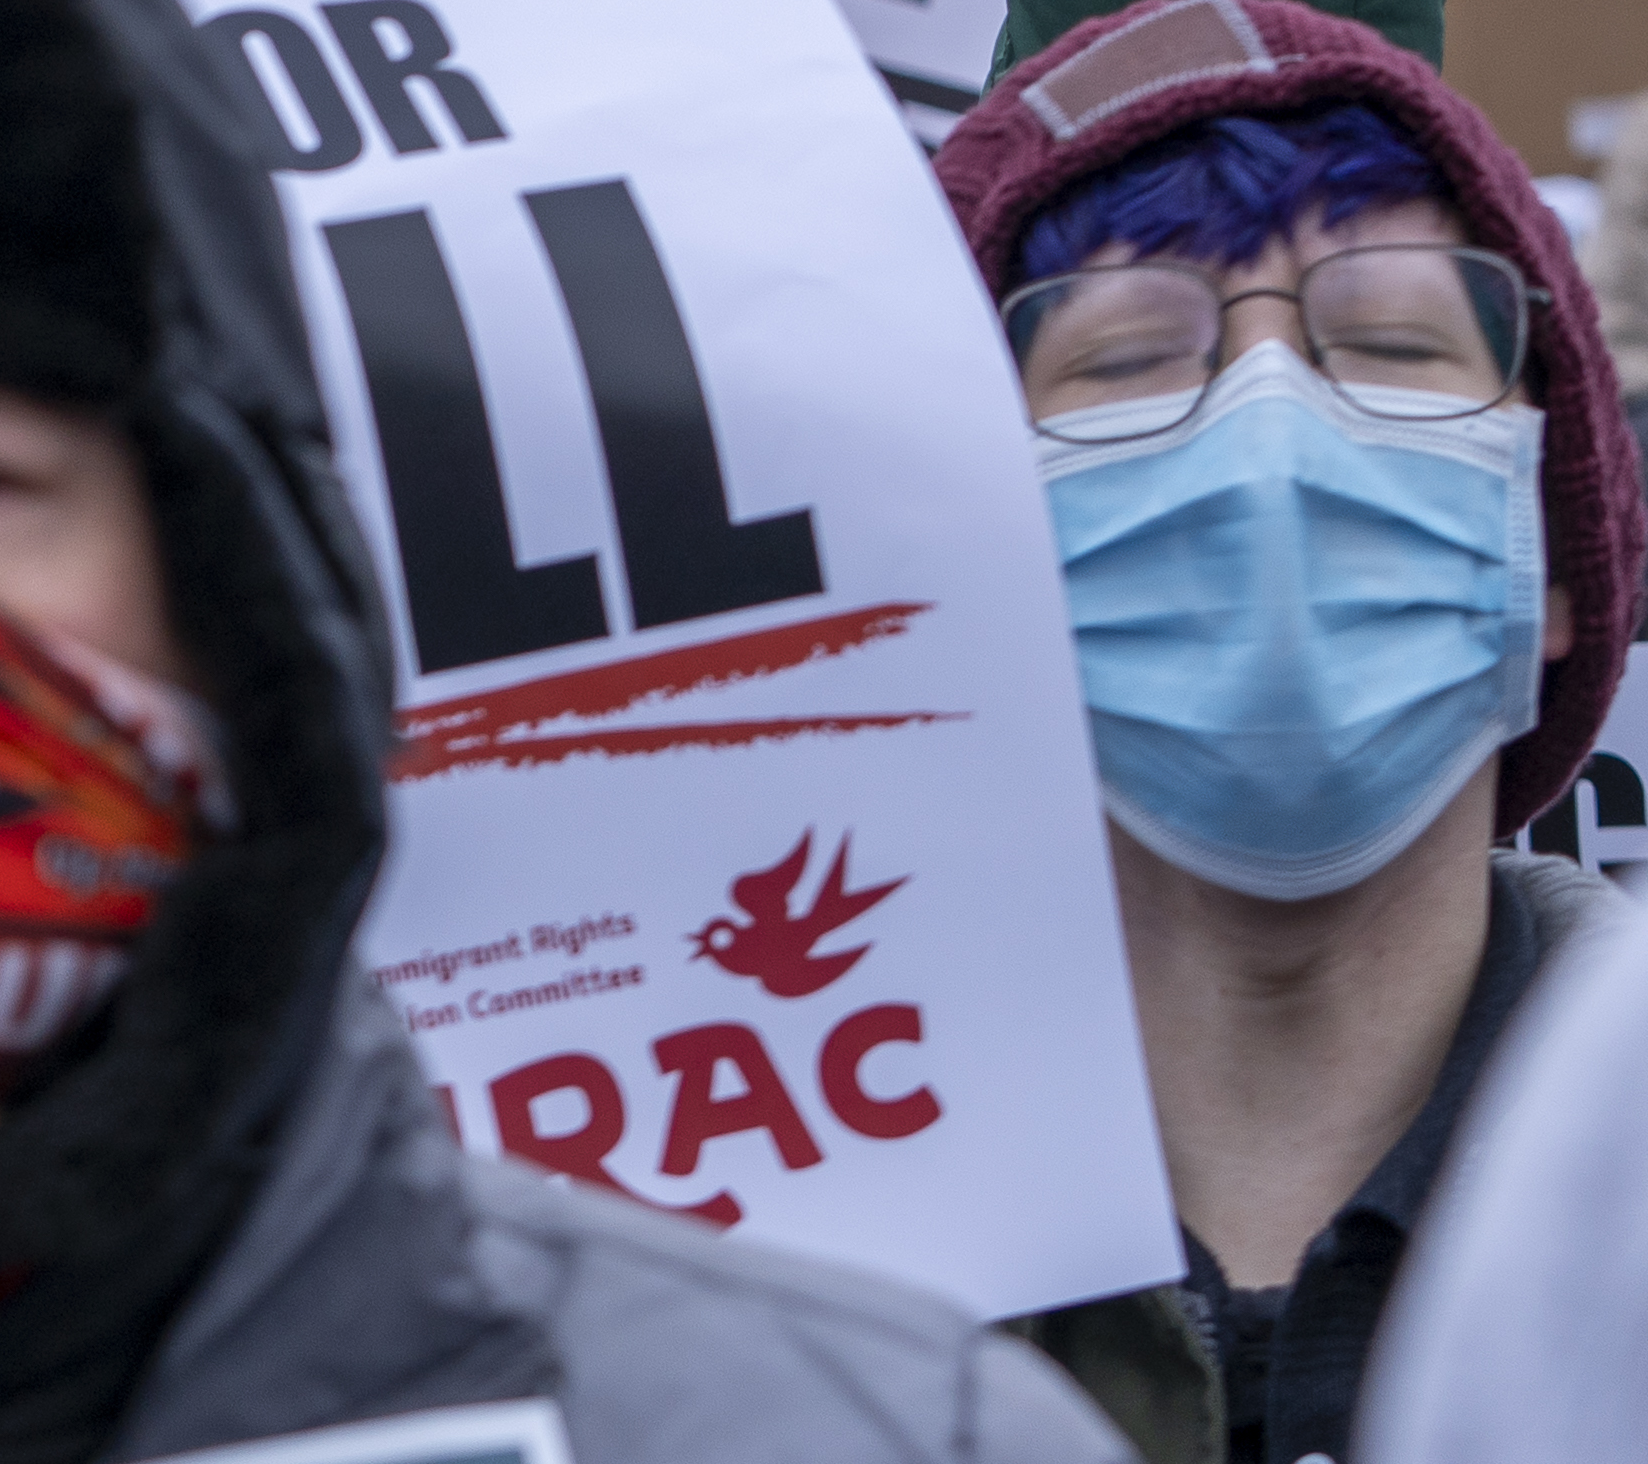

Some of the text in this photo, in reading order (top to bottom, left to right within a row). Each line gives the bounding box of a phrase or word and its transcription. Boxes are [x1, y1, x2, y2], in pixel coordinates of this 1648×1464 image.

[321, 175, 828, 677] LL
[374, 913, 636, 986] mmigrant Rights
[407, 963, 645, 1034] ion Committee
[433, 1003, 944, 1234] RAC
